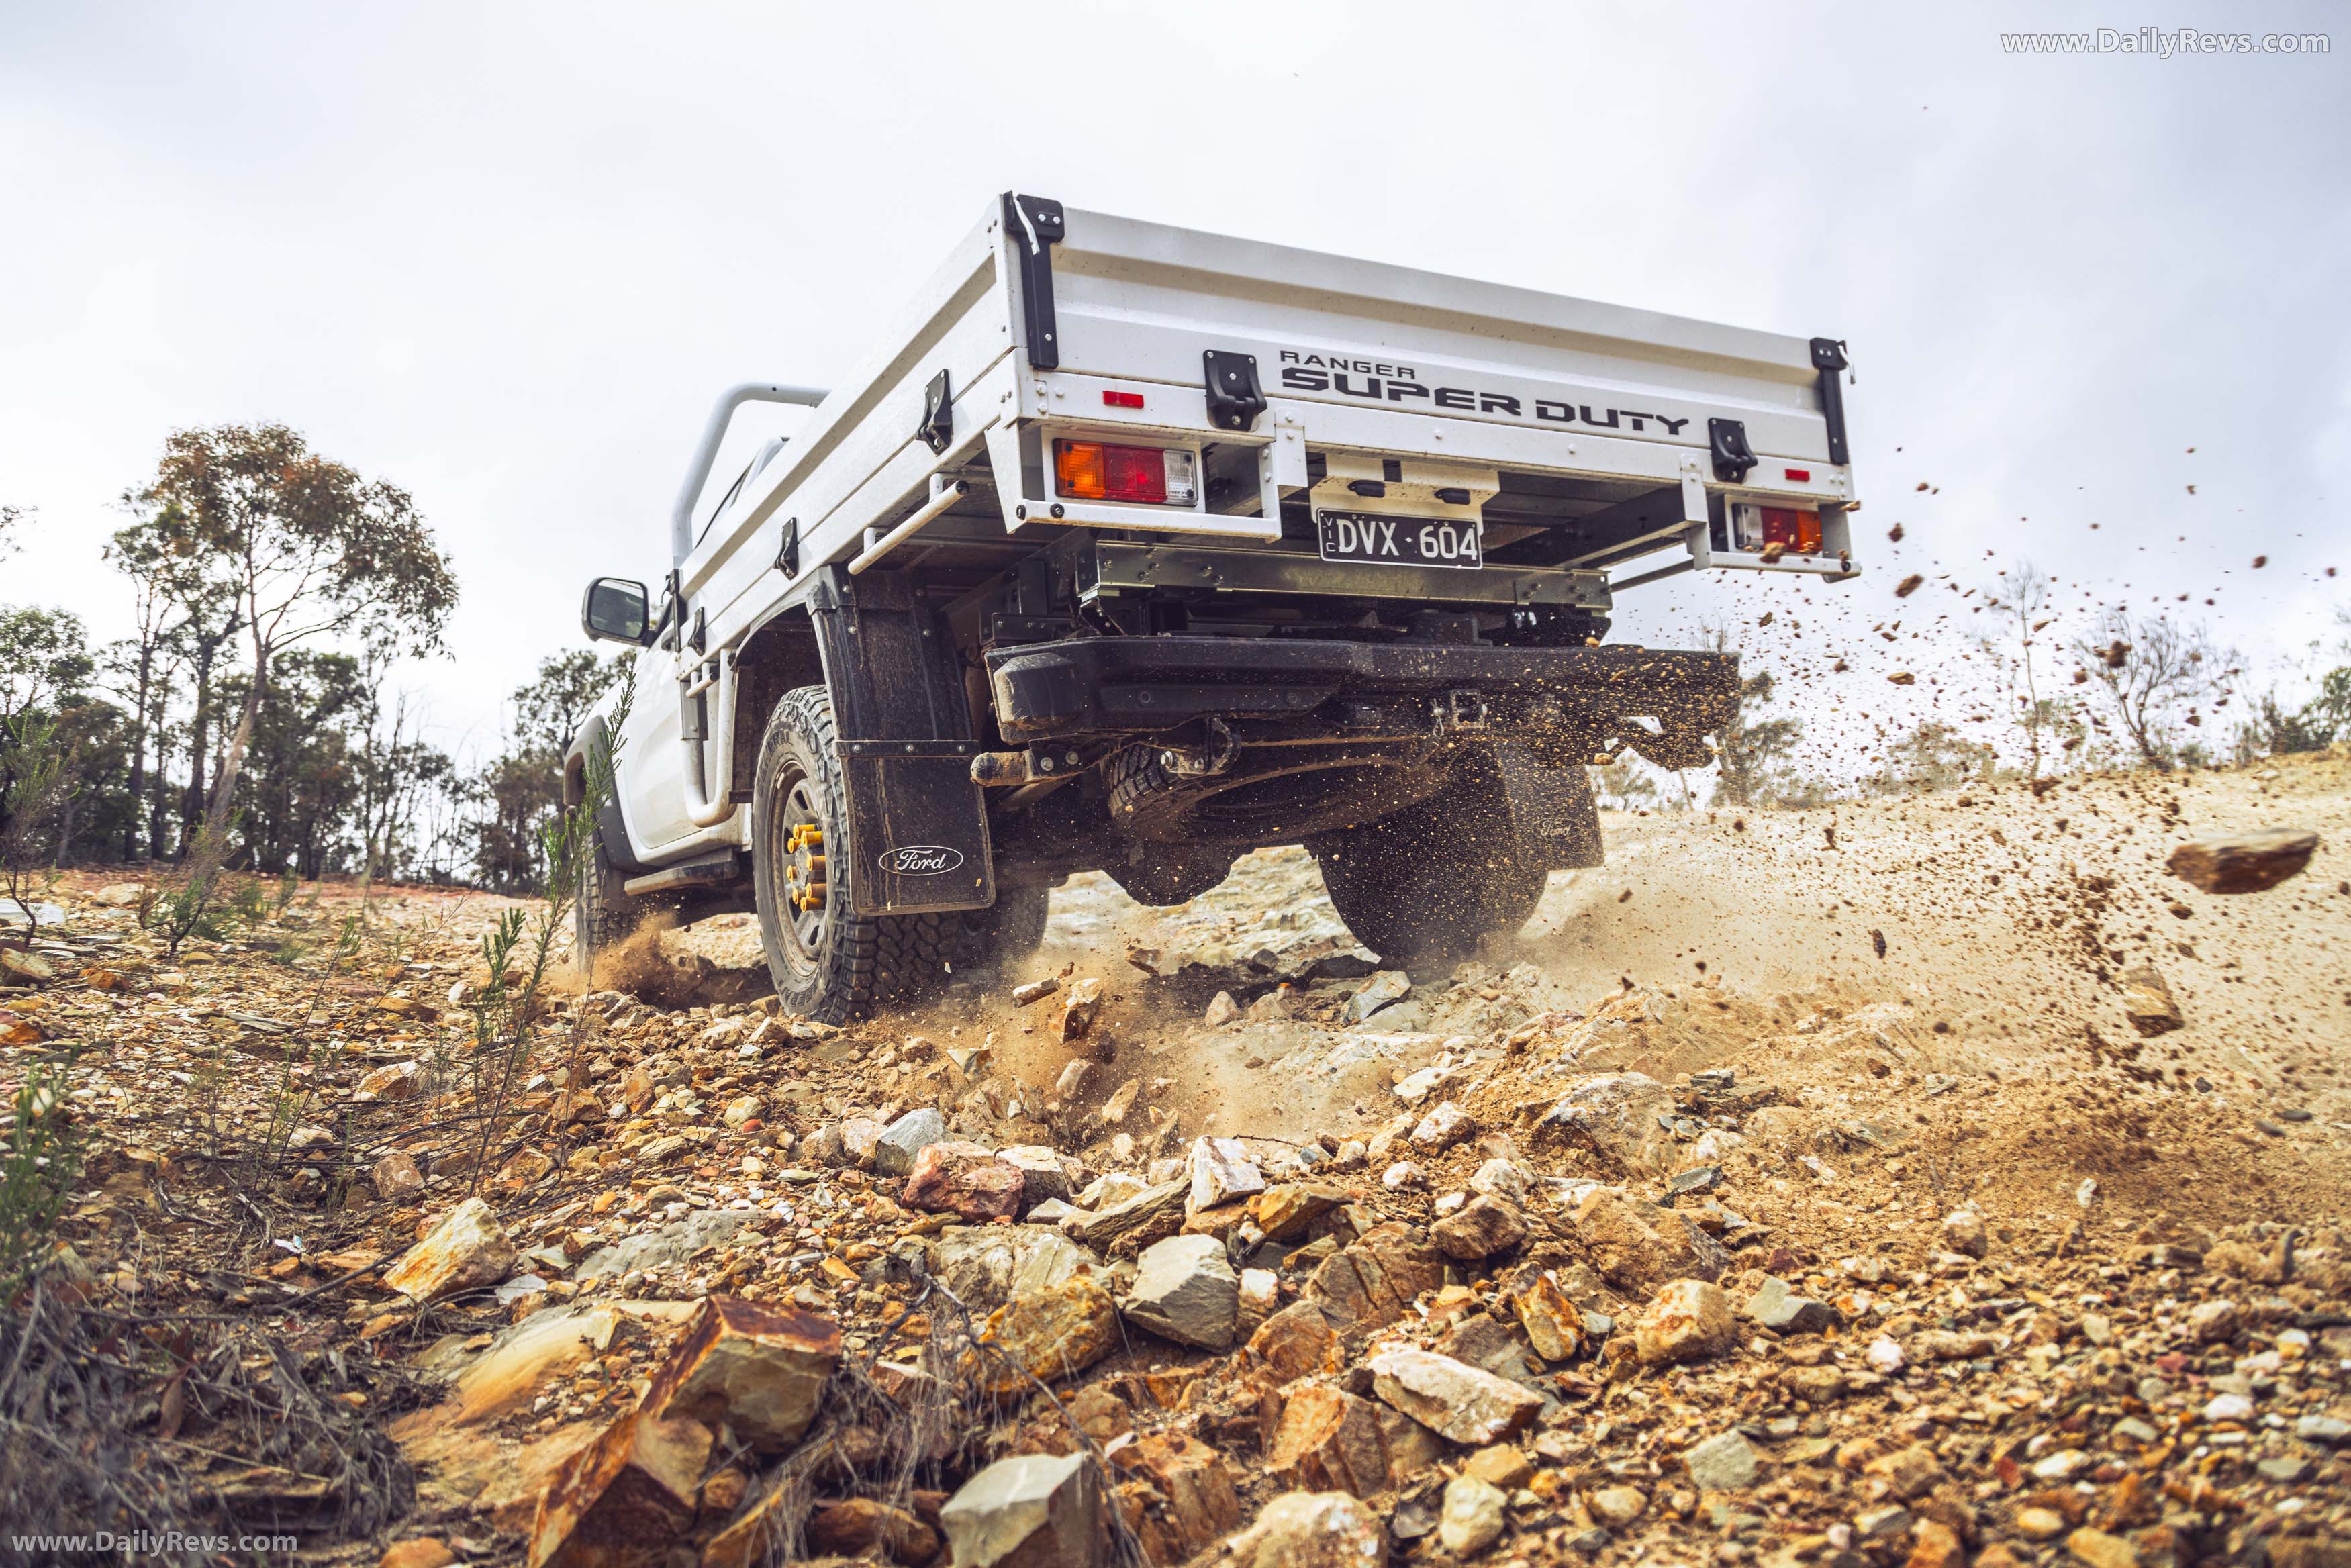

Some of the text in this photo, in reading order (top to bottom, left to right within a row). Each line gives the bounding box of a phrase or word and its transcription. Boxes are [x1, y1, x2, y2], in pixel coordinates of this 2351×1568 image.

[1280, 350, 1416, 379] RANGER
[1282, 367, 1689, 436] SUPER DUTY
[1325, 517, 1336, 552] VIC
[1336, 518, 1478, 560] DVX 604
[896, 849, 946, 870] Ford
